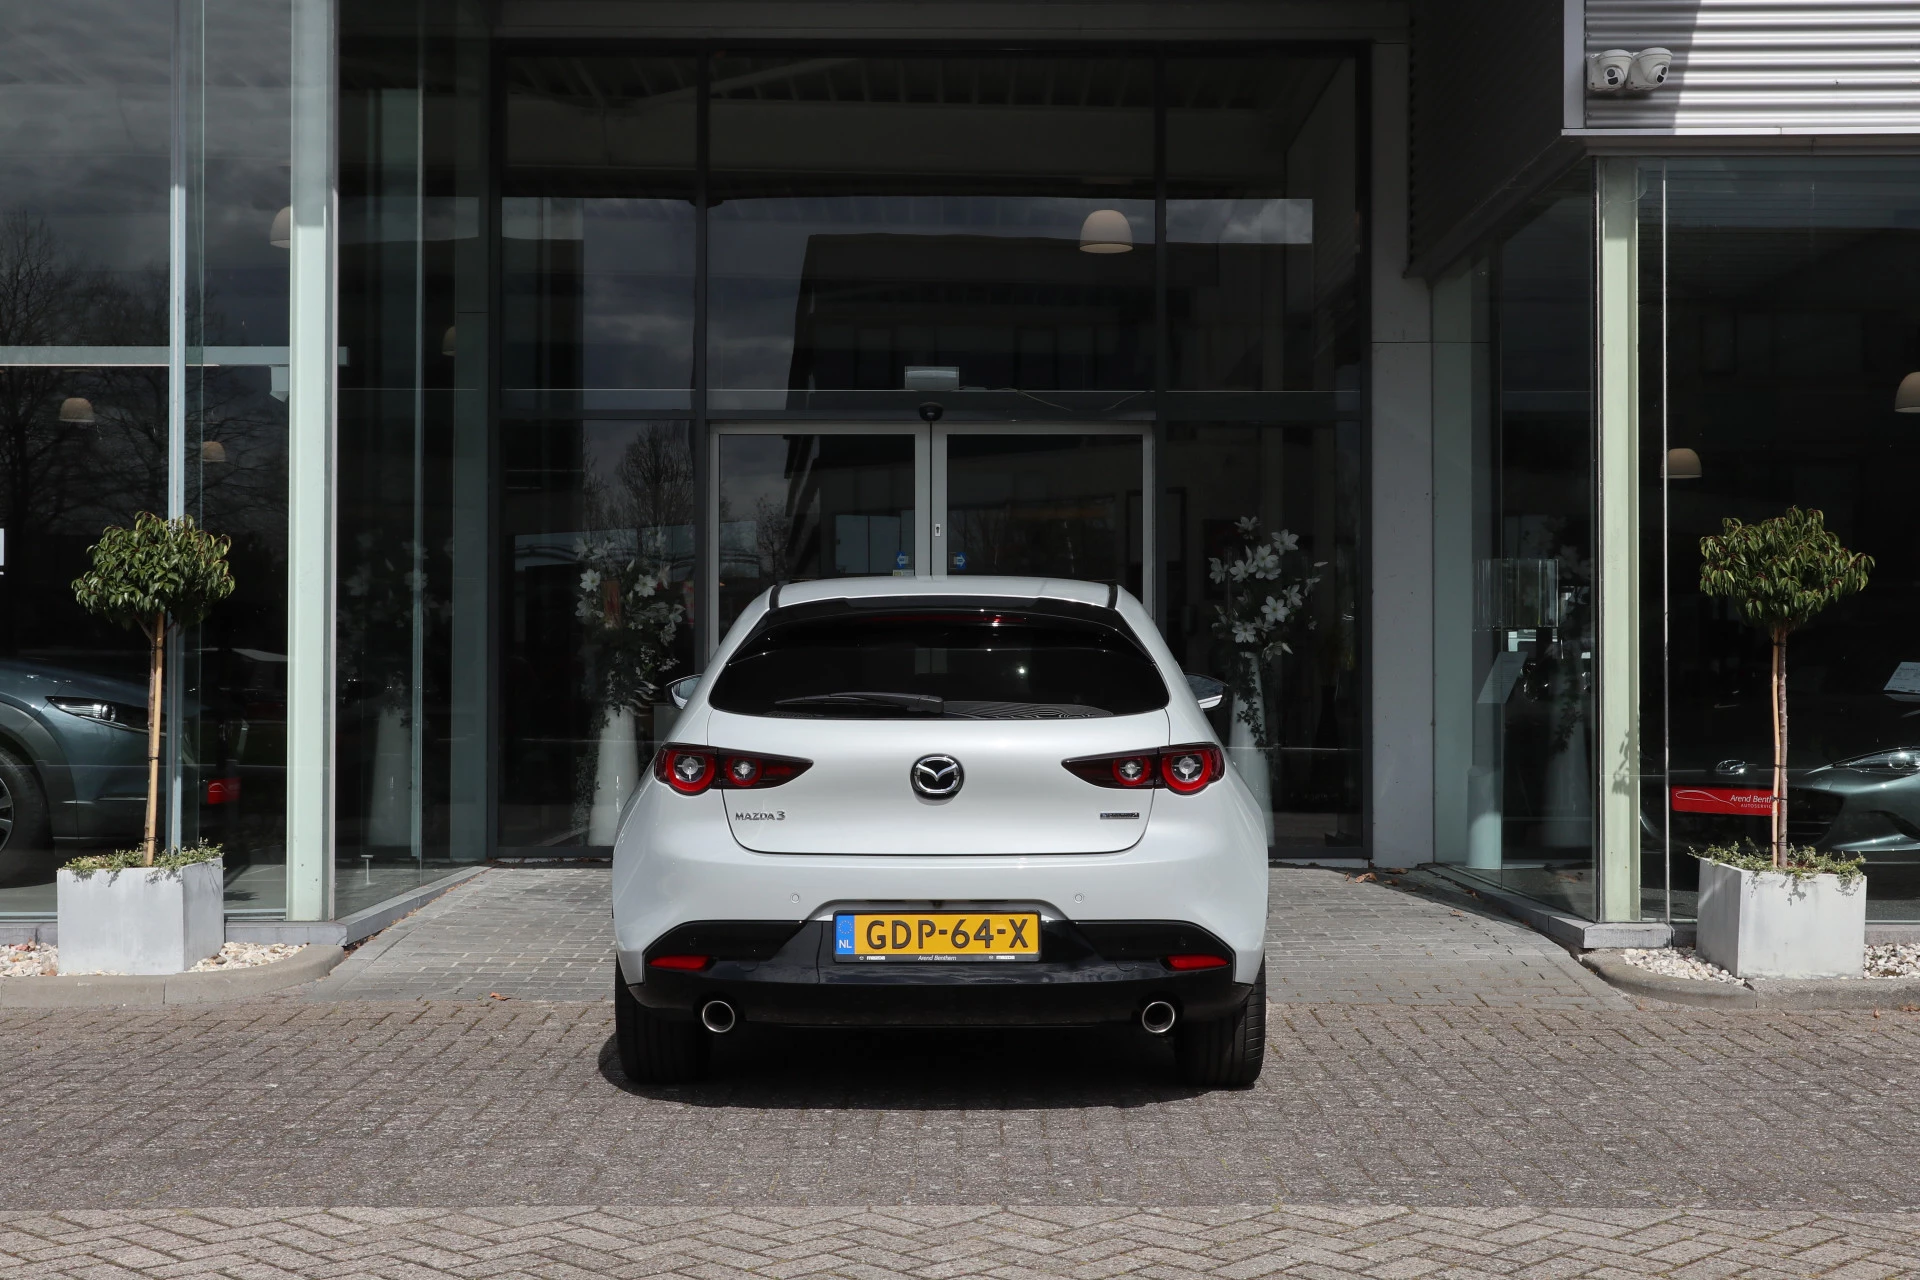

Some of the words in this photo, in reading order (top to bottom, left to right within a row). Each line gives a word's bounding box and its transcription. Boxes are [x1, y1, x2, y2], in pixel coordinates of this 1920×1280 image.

[1730, 794, 1752, 803] Arend
[866, 918, 1029, 949] GDP-64-X
[838, 940, 852, 949] NL
